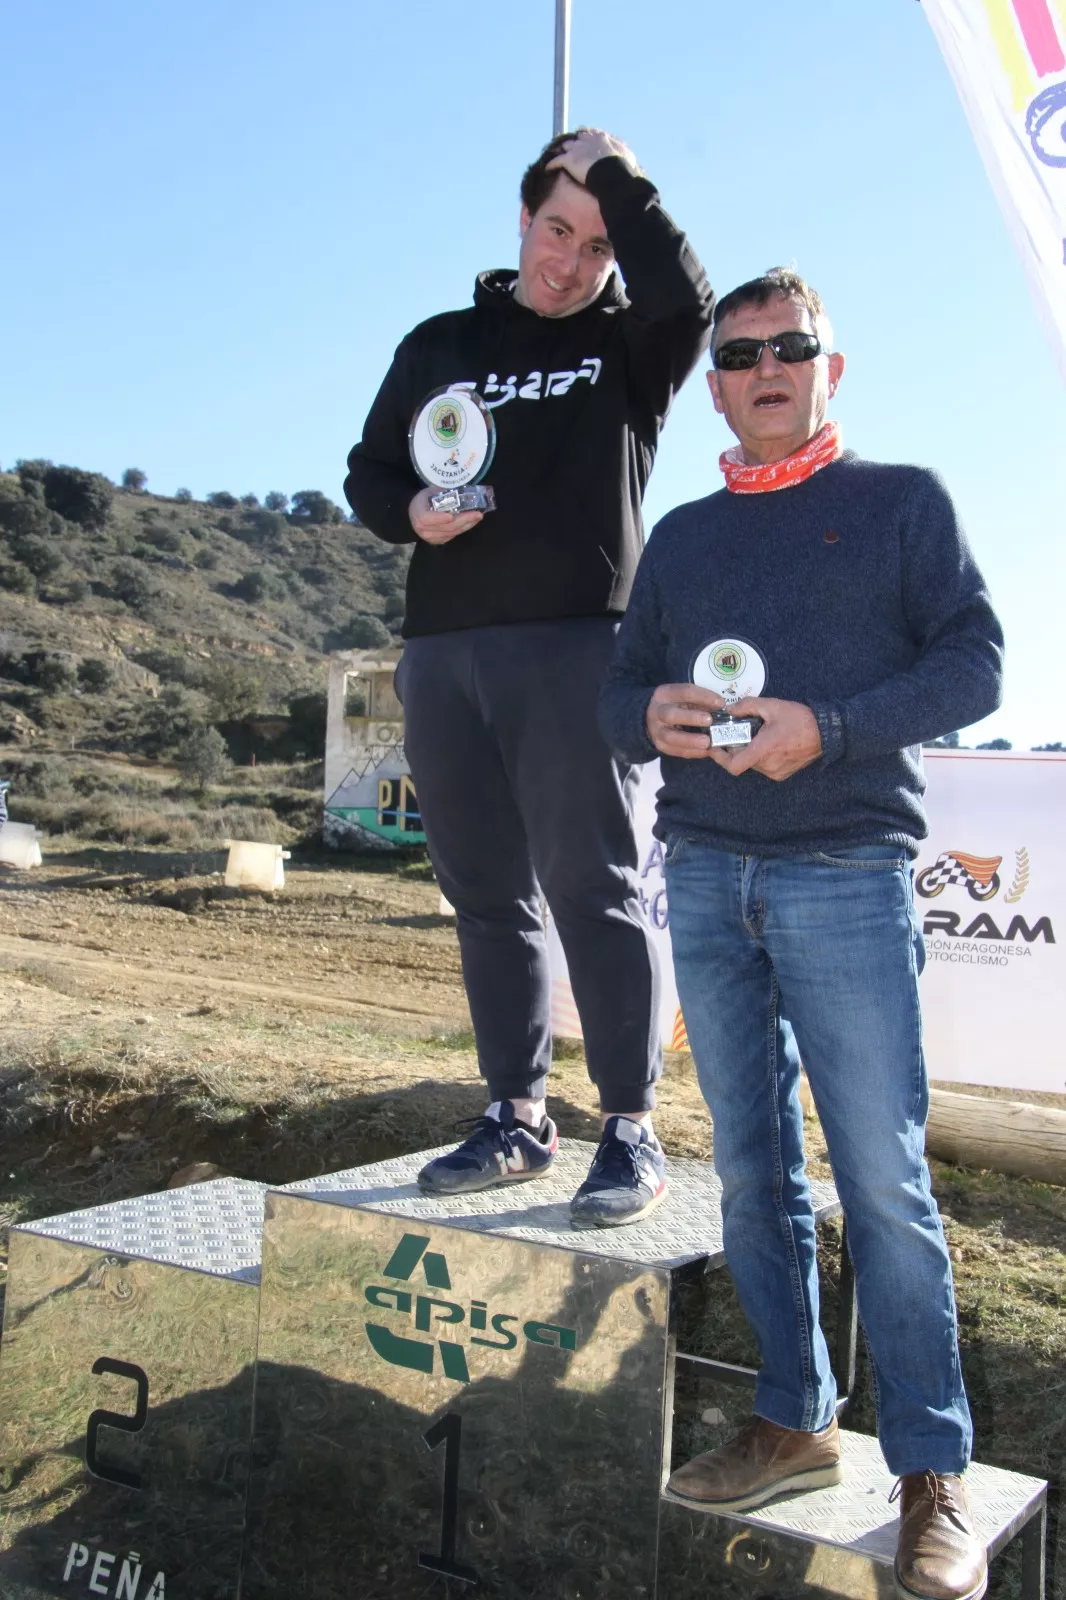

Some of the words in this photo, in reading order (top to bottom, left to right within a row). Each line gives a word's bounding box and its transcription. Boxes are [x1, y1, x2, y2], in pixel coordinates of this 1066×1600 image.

[430, 463, 465, 478] JACETANIA
[923, 909, 1056, 944] RAM
[925, 951, 1009, 967] OTOCICLISMO
[954, 942, 1032, 957] ARAGONESA
[86, 1356, 149, 1491] 2
[419, 1412, 479, 1585] 1
[62, 1541, 166, 1600] PEÑA
